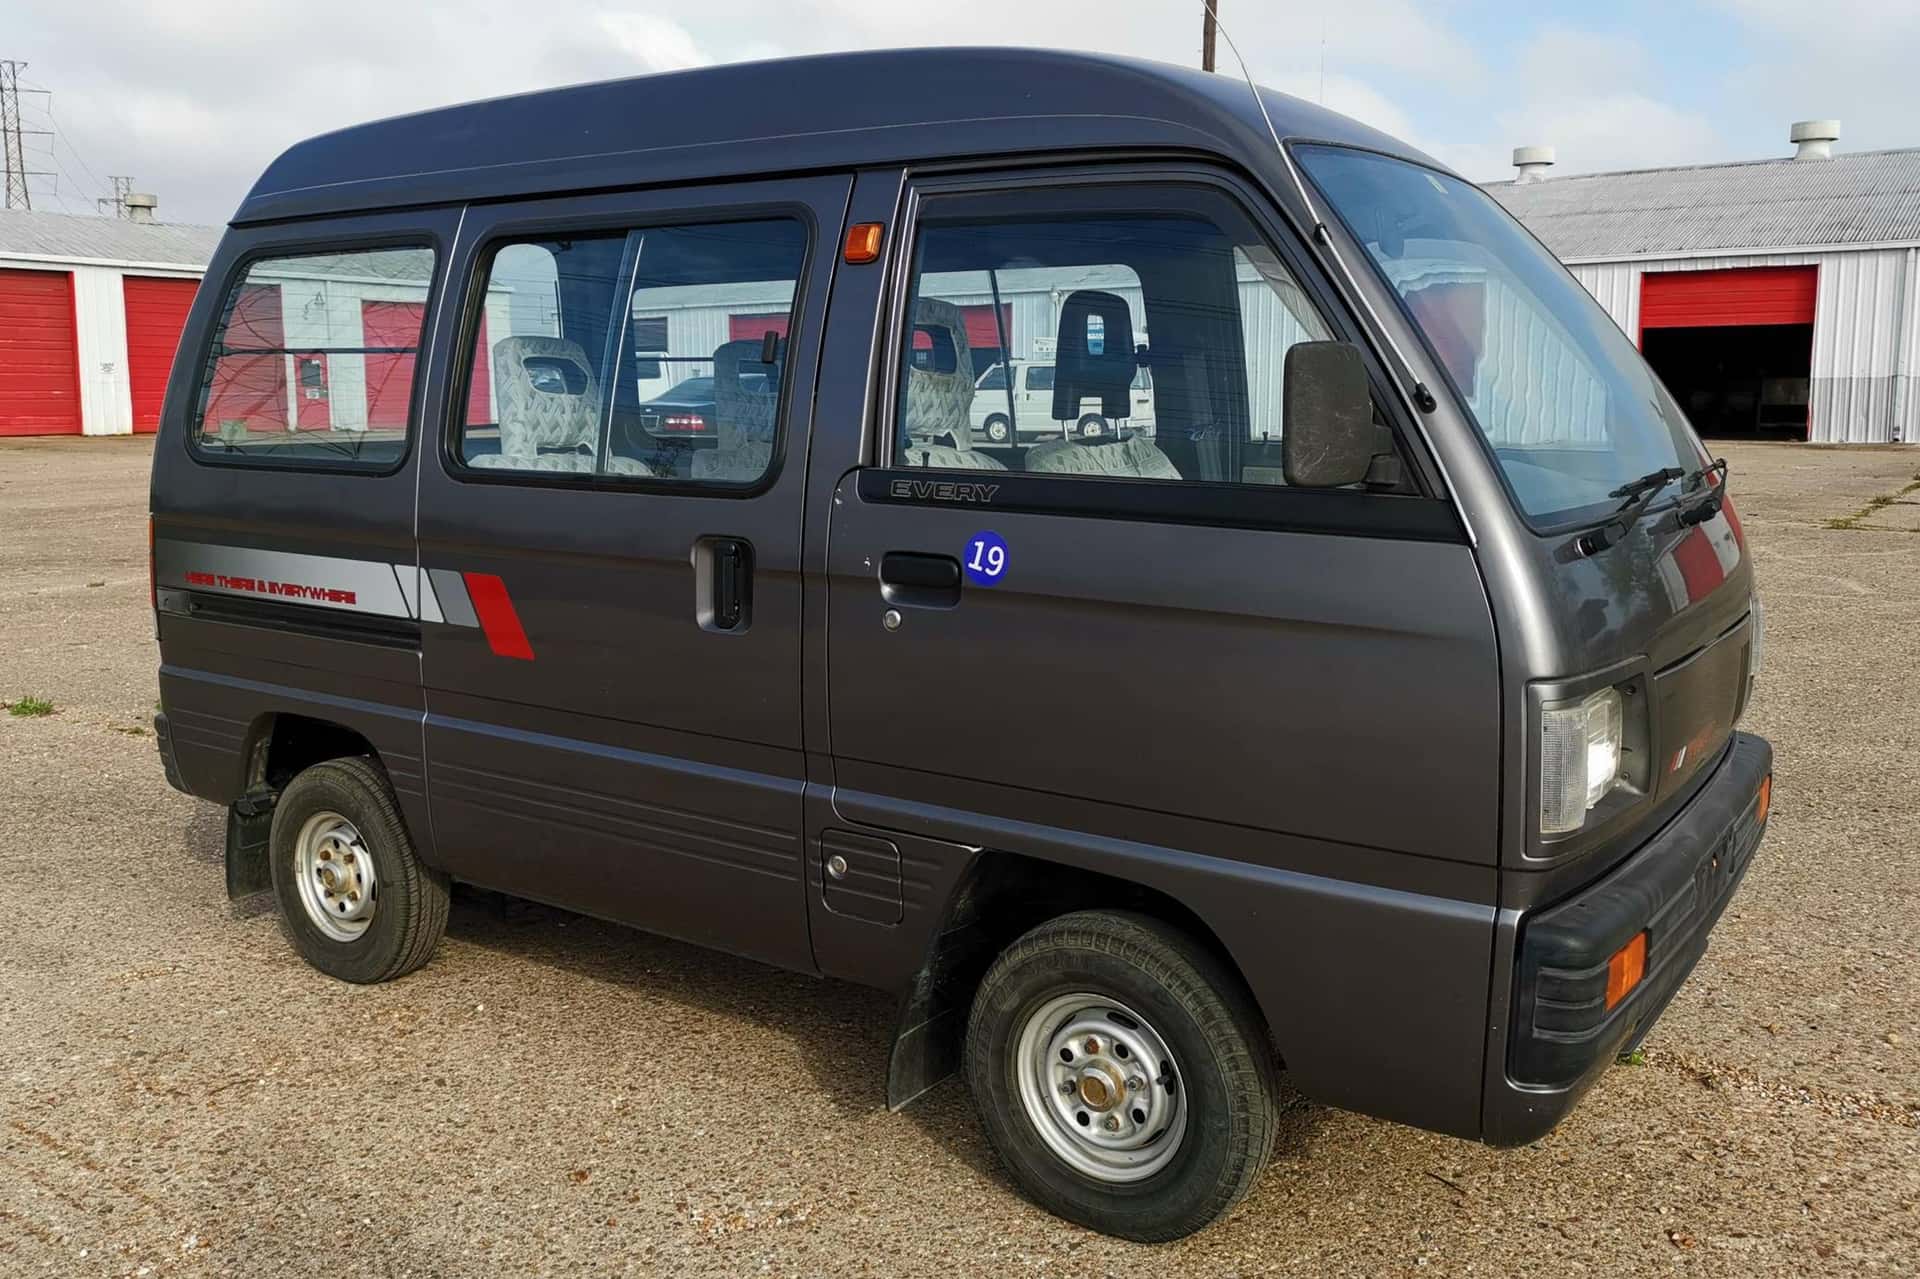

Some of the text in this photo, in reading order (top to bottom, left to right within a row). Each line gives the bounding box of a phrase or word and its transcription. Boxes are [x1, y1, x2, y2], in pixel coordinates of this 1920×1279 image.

[890, 479, 1000, 502] EVERY
[968, 541, 1005, 576] 19
[217, 575, 255, 591] THERE
[257, 580, 266, 592] &
[268, 581, 357, 605] EVERYWHERE
